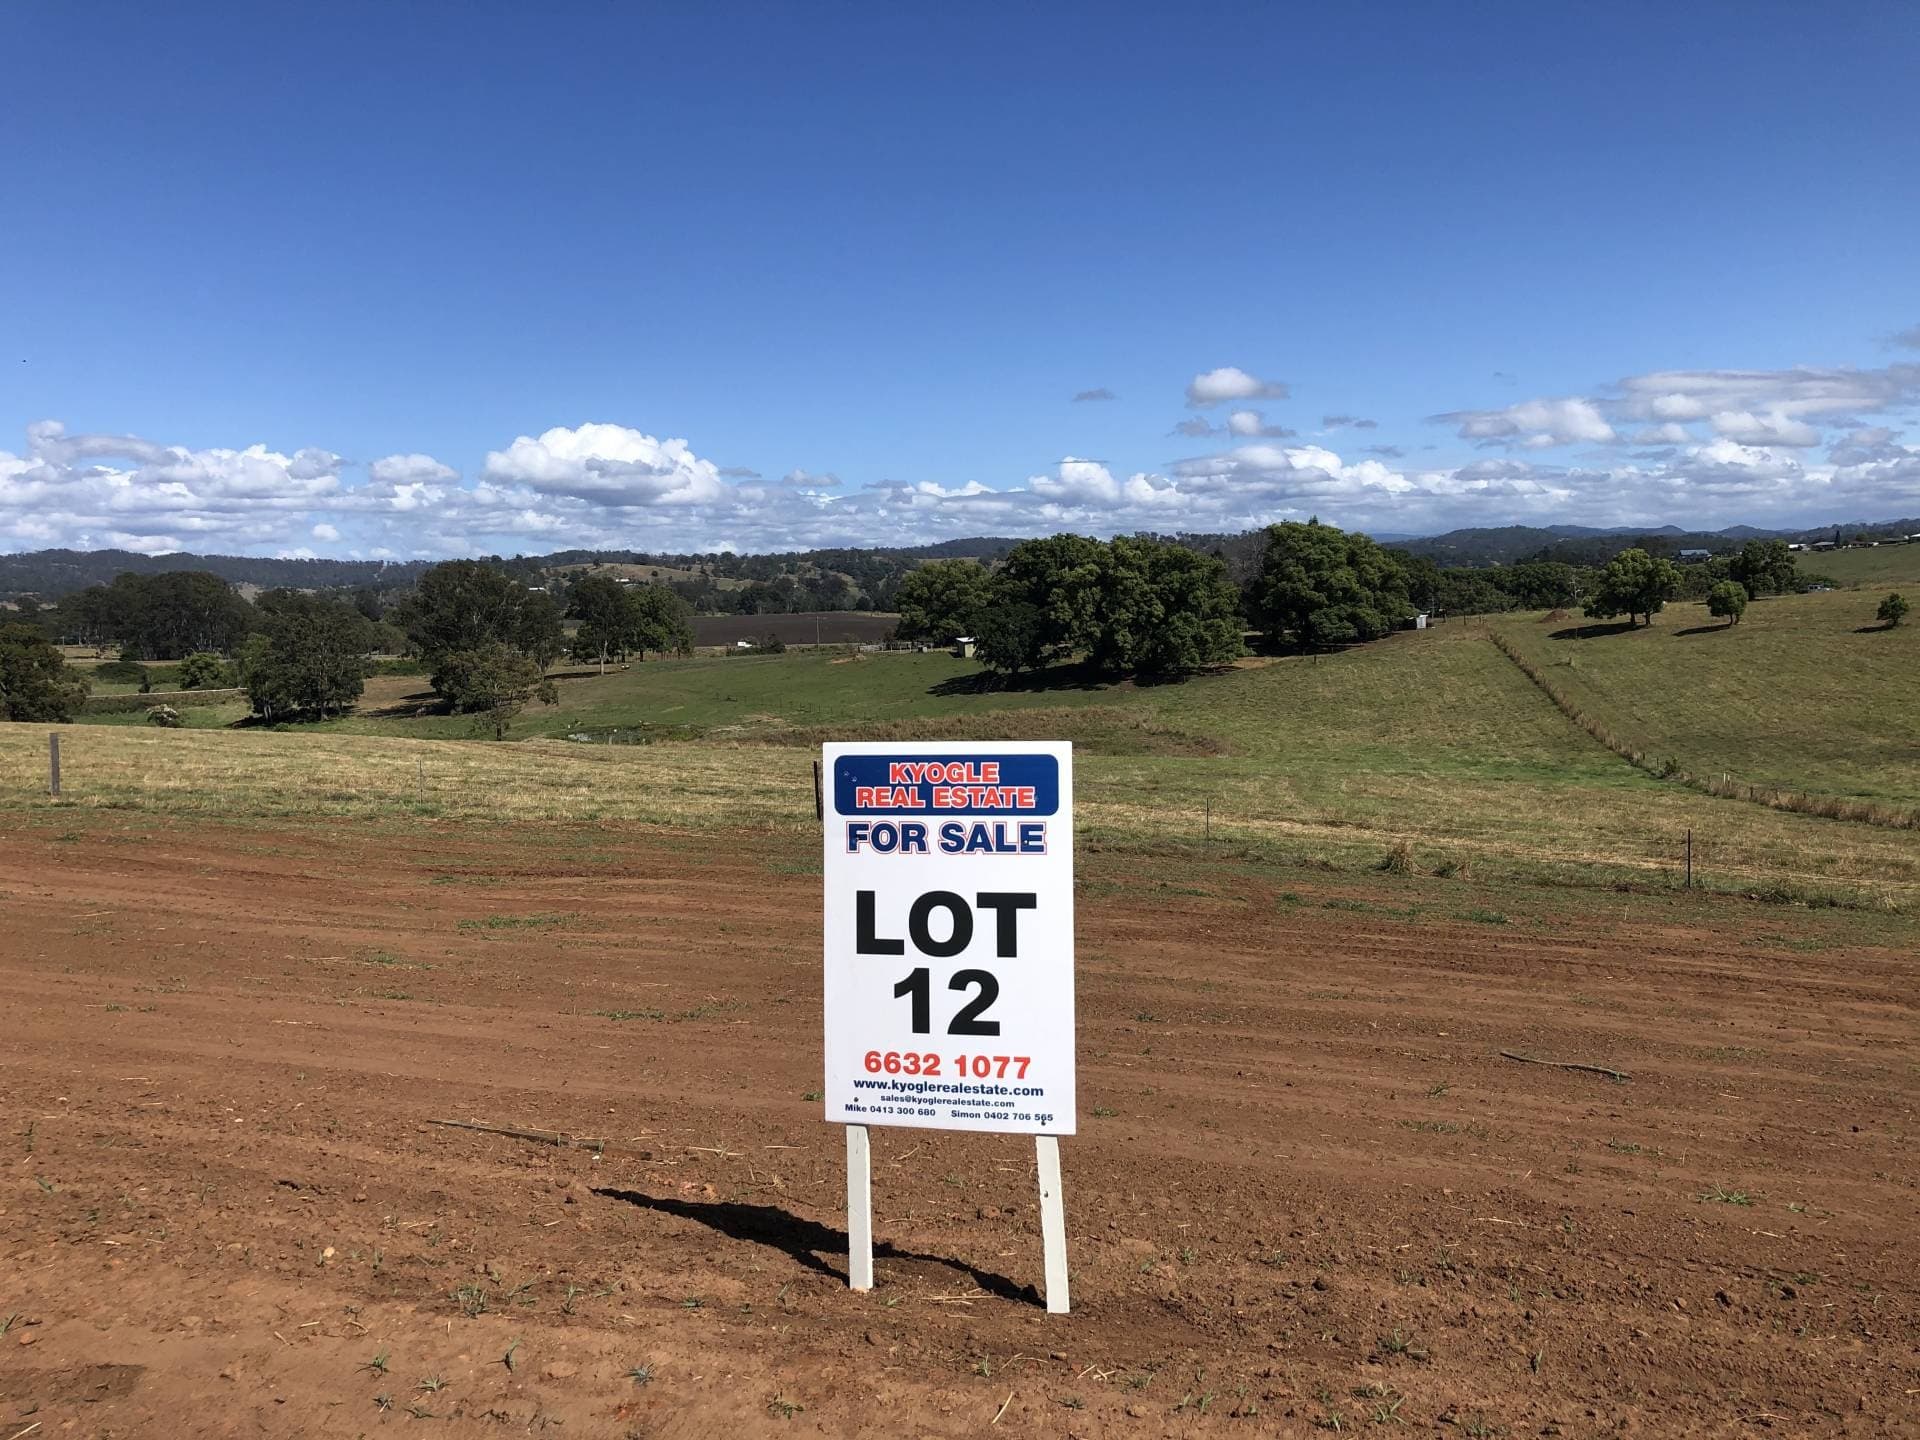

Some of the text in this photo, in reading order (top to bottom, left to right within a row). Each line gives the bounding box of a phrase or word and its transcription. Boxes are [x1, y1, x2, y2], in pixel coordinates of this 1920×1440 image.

[889, 762, 999, 784] KYOGLE
[856, 786, 1035, 808] REAL ESTATE
[846, 820, 1047, 855] FOR SALE
[856, 890, 1037, 958] LOT
[894, 967, 1000, 1036] 12
[864, 1050, 1031, 1079] 6632 1077
[853, 1079, 1044, 1096] www.kyoglerealestate.com
[845, 1104, 936, 1116] Mike 0413 300 680
[880, 1094, 1015, 1108] sales@kyoglerealestate.com
[951, 1109, 980, 1119] Simon
[984, 1111, 1009, 1120] 0402
[1013, 1112, 1031, 1121] 706
